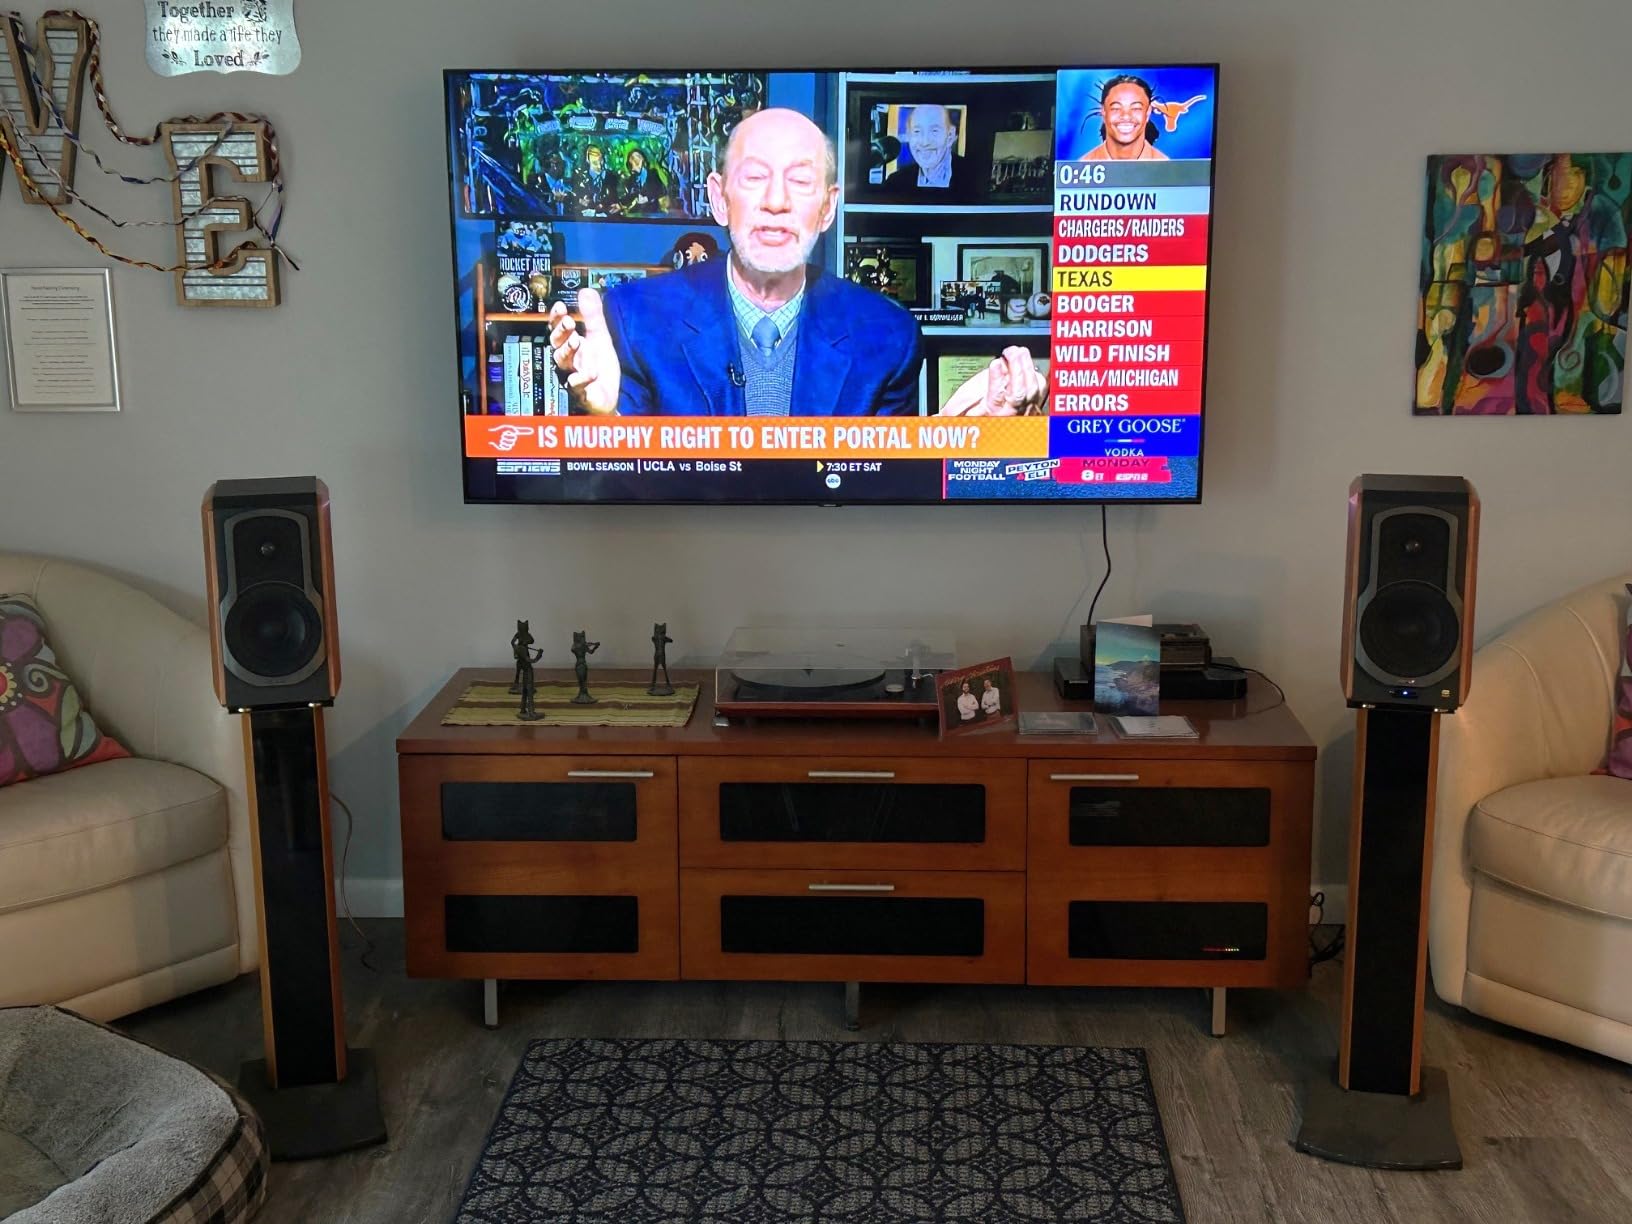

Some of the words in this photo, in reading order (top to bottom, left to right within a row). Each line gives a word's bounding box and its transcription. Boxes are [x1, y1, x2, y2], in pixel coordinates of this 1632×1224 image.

[158, 1, 235, 24] Together
[152, 26, 179, 44] they
[183, 26, 217, 42] made
[220, 30, 227, 42] a
[230, 25, 251, 42] life
[255, 27, 282, 45] they
[193, 50, 244, 67] Loved
[1059, 164, 1106, 185] 0:46
[1060, 193, 1157, 212] RUNDOWN
[1058, 217, 1185, 238] CHARGERS/RAIDERS
[1058, 244, 1149, 264] DODGERS
[1057, 270, 1113, 288] TEXAS
[1056, 294, 1135, 314] BOOGER
[1056, 319, 1153, 339] HARRISON
[1055, 344, 1102, 363] WILD
[1107, 344, 1170, 363] FINISH
[1055, 368, 1179, 388] 'BAMA/MICHIGAN
[1054, 394, 1130, 413] ERRORS
[1067, 419, 1114, 434] GREY
[1118, 418, 1183, 433] GOOSE
[537, 425, 558, 449] IS
[564, 425, 654, 449] MURPHY
[660, 425, 723, 449] RIGHT
[728, 426, 754, 449] TO
[761, 426, 826, 449] ENTER
[833, 426, 912, 449] PORTAL
[918, 425, 981, 449] NOW?
[1104, 448, 1145, 457] VODKA
[566, 462, 595, 471] BOWL
[595, 462, 634, 471] SEASON
[643, 461, 676, 472] UCLA
[679, 463, 692, 472] vs
[695, 461, 727, 472] Boise
[728, 461, 742, 472] St
[826, 462, 848, 472] 7:30
[849, 462, 862, 472] ET
[863, 462, 883, 472] SAT
[953, 460, 1000, 468] MONDAY
[1007, 459, 1060, 473] PEYTON
[1082, 459, 1150, 468] MONDAY
[947, 473, 1006, 481] FOOTBALL
[1027, 470, 1048, 479] ELI
